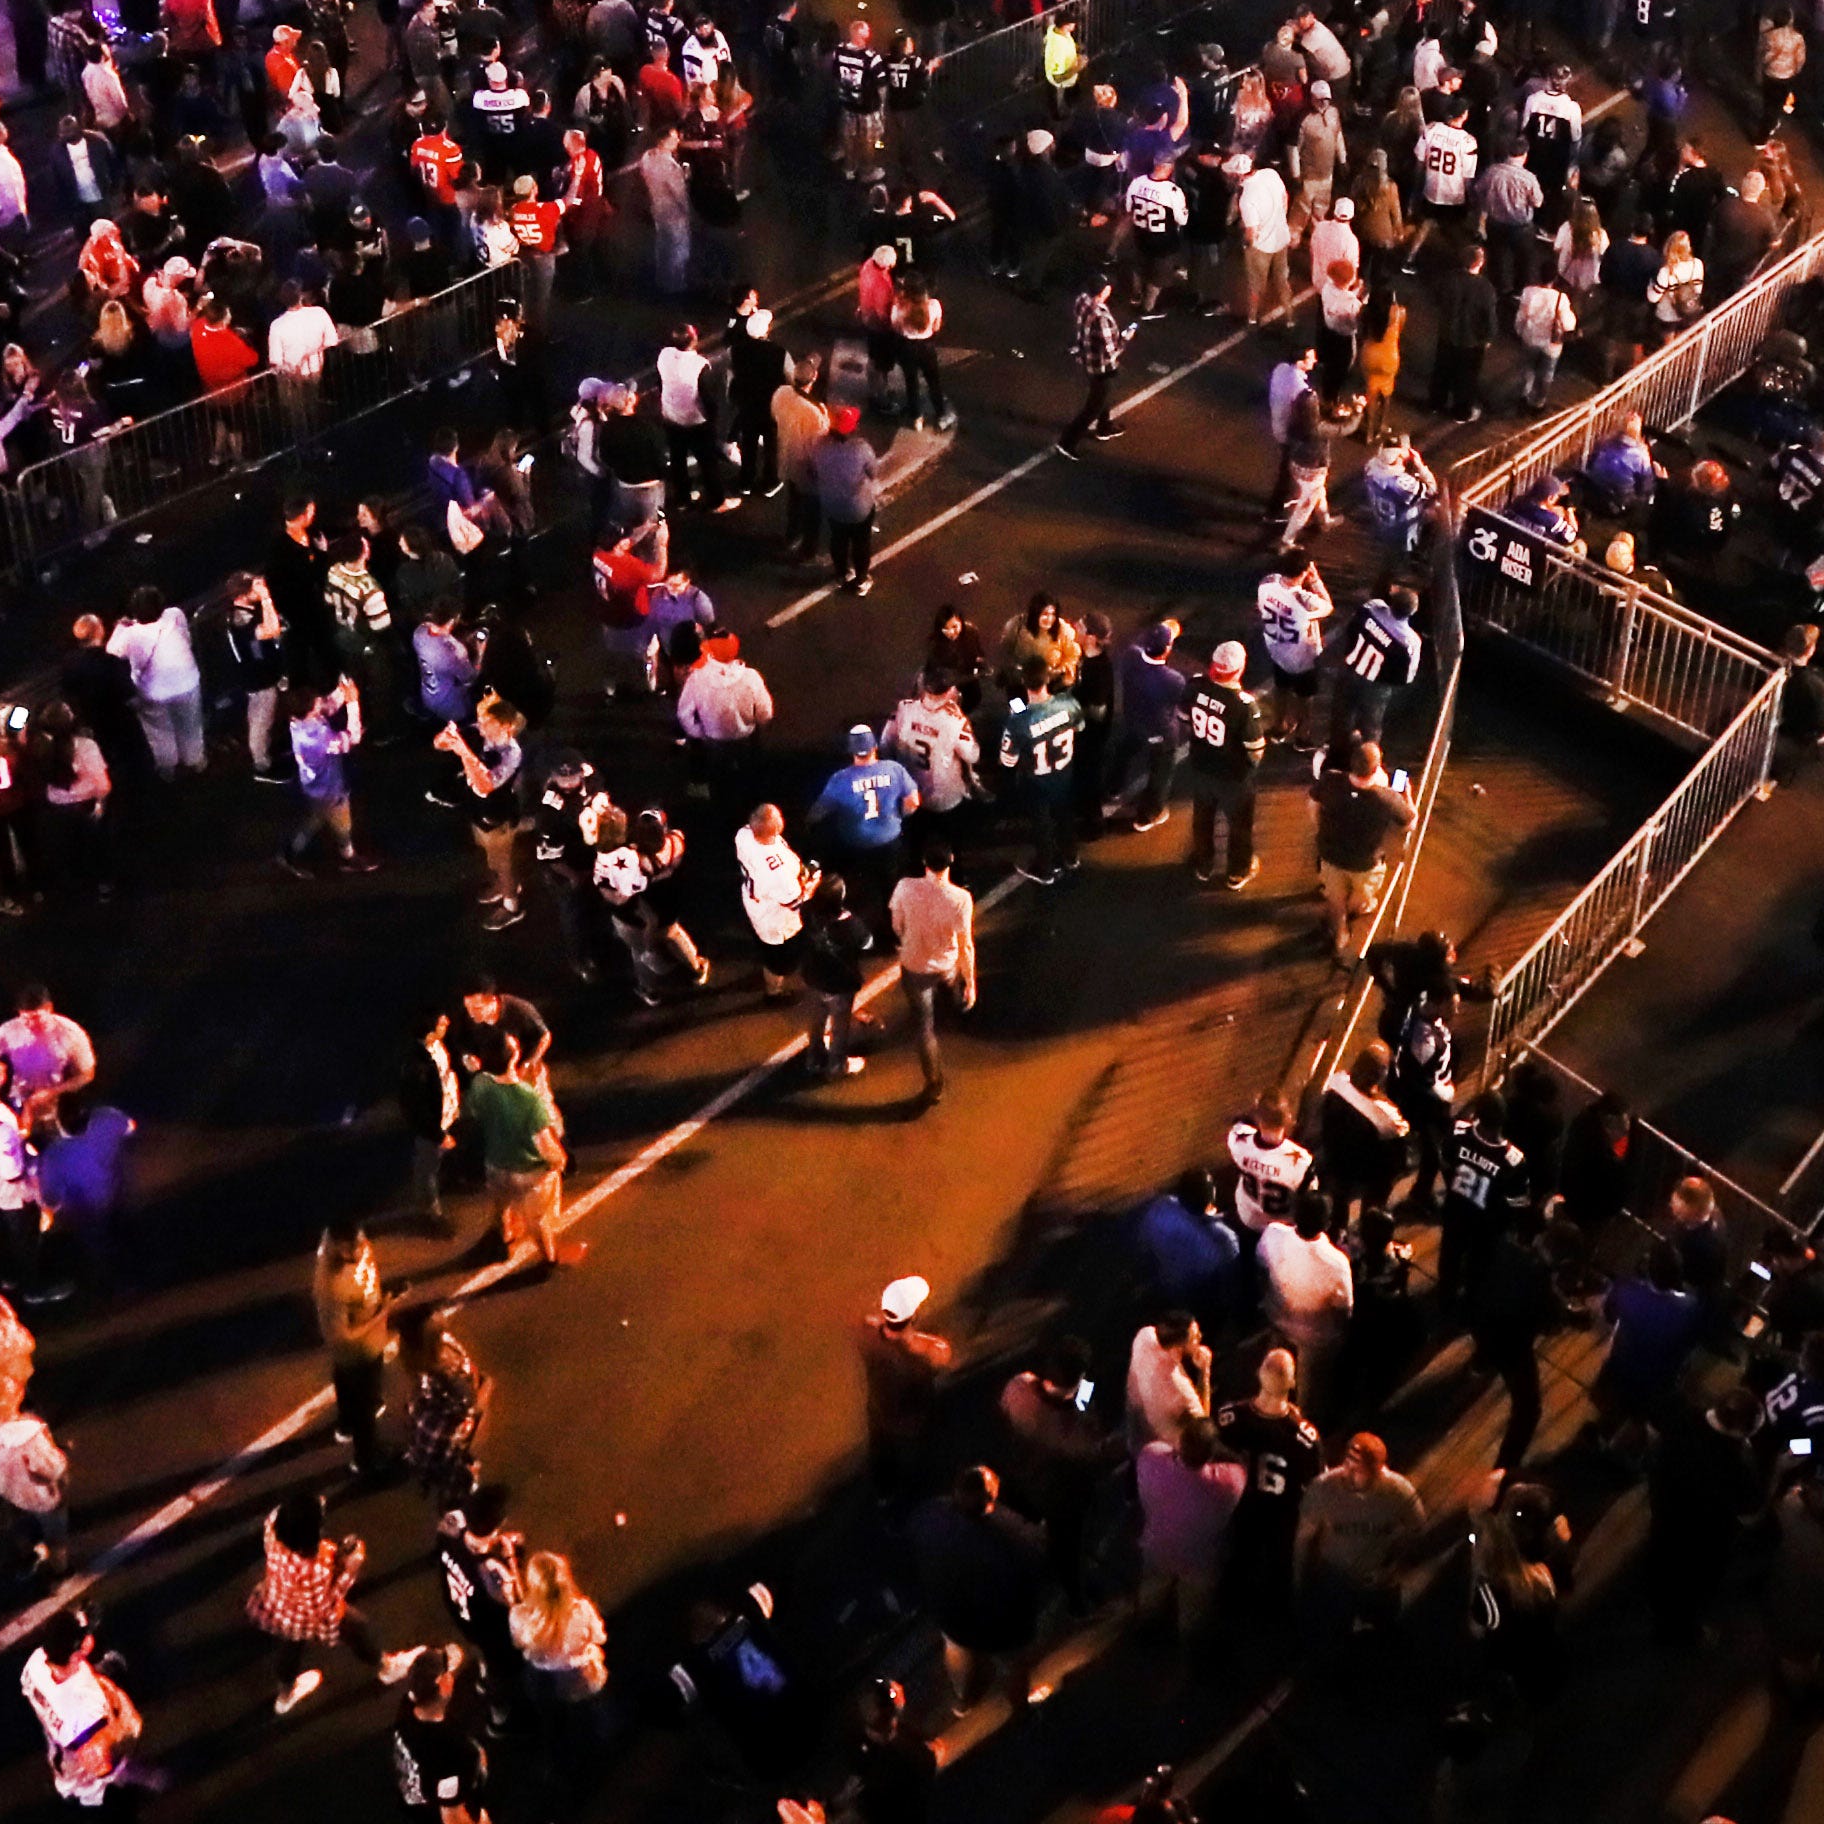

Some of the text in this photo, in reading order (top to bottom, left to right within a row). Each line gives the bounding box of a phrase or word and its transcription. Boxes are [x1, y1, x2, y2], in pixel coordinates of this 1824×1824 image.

[486, 113, 515, 134] 55
[419, 160, 439, 188] 13
[1429, 147, 1457, 176] 28
[1133, 194, 1167, 234] 22
[514, 223, 544, 247] 25
[896, 236, 914, 264] 7
[1506, 541, 1531, 563] ADA
[1501, 558, 1534, 587] RISER
[1263, 604, 1300, 644] 25
[1190, 706, 1227, 748] 99
[914, 740, 931, 771] 3
[1032, 727, 1077, 777] 13
[864, 789, 880, 819] 1
[1451, 1162, 1492, 1210] 21
